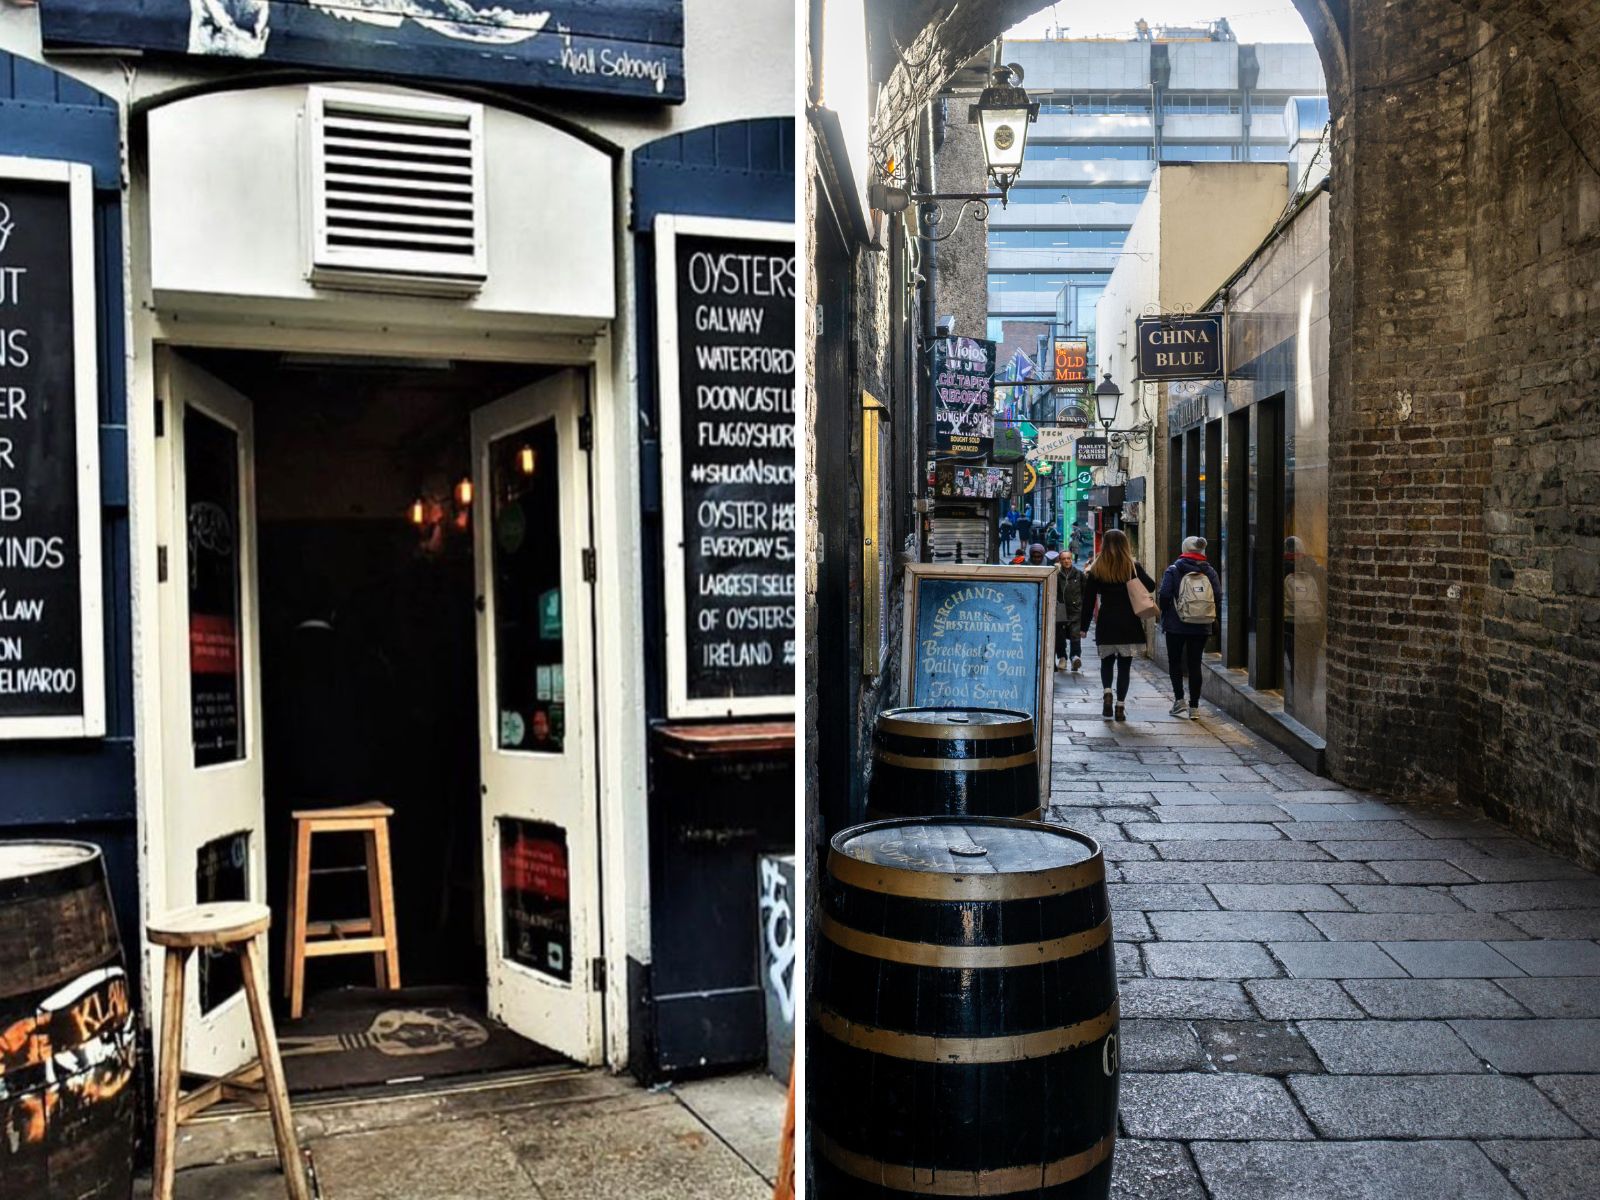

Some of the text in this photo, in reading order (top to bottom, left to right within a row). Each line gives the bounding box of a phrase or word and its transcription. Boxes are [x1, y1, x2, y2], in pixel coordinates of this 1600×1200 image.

[689, 252, 795, 297] OYSTERS
[695, 305, 764, 334] GALWAY
[1148, 330, 1210, 345] CHINA
[696, 345, 795, 374] WATERFORD
[1156, 351, 1205, 367] BLUE
[957, 375, 990, 391] TAPES
[1057, 386, 1084, 394] GUINNESS
[941, 388, 988, 405] RECORDS
[950, 436, 968, 444] BOUGHT
[951, 445, 979, 453] EXCHANGED
[698, 501, 768, 530] OYSTER
[700, 536, 774, 558] EVERYDAY
[700, 573, 758, 597] LARGEST
[699, 606, 795, 631] OF OYSTERS
[932, 587, 1024, 642] MERCHANTS ARCH
[959, 610, 994, 622] BAR &
[945, 620, 1012, 633] RESTAURANT
[703, 639, 773, 667] IRELAND
[922, 639, 1025, 660] Breakfast Served
[922, 658, 1026, 678] Daily from 9am
[930, 681, 1019, 700] Food Served
